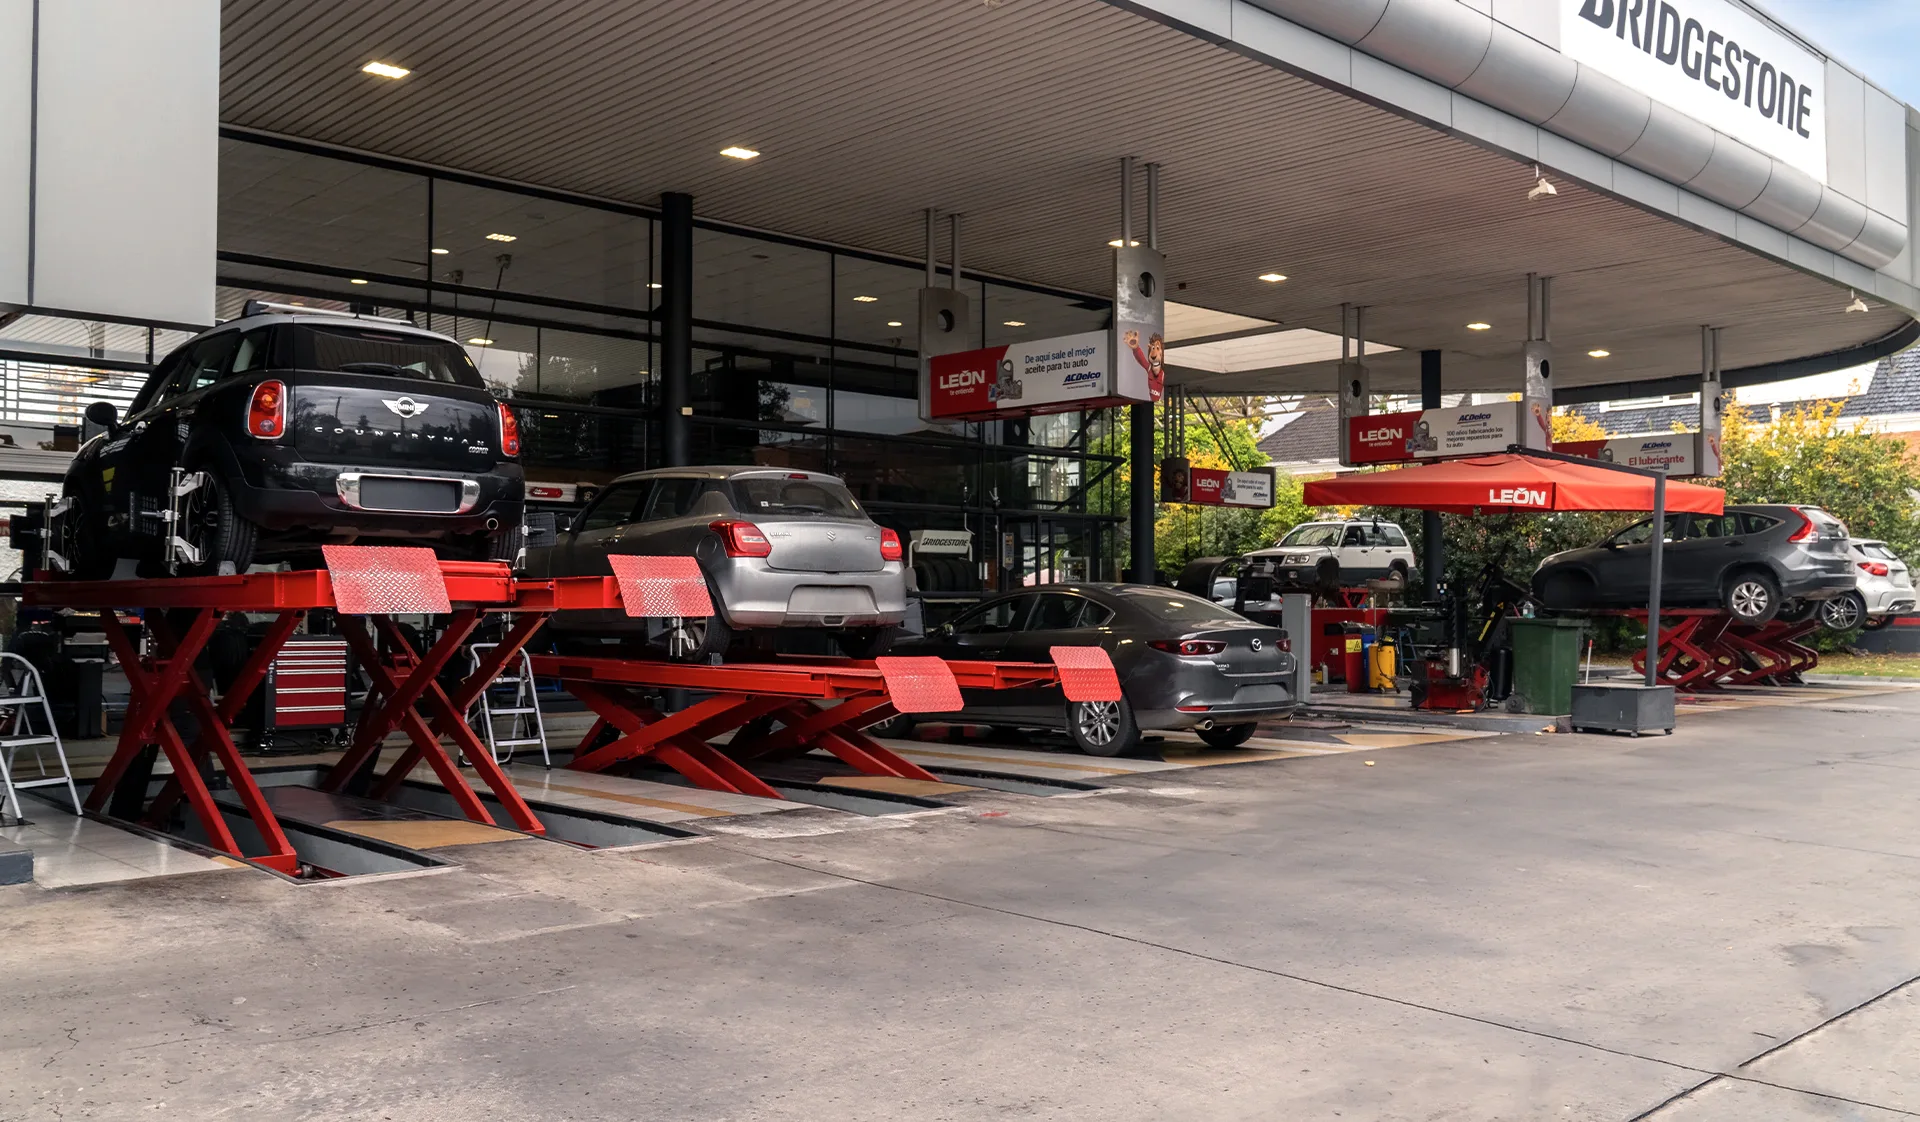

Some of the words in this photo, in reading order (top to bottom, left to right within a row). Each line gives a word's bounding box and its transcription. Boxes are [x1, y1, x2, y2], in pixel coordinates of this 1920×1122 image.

[1025, 355, 1034, 364] De
[1035, 352, 1050, 365] aquí
[1051, 350, 1066, 360] sale
[1067, 348, 1074, 358] el
[1075, 346, 1096, 359] mejor
[1024, 363, 1045, 375] aceite
[1046, 362, 1062, 374] para
[1063, 360, 1072, 370] tu
[1073, 358, 1089, 369] auto
[1064, 371, 1101, 383] ACDelco
[949, 388, 956, 396] te
[956, 386, 975, 396] entiende
[1458, 412, 1492, 422] ACDelco
[314, 426, 485, 446] COUNTRYMAN
[1468, 427, 1495, 435] fabricando
[1446, 436, 1465, 444] mejores
[1466, 434, 1490, 443] repuestos
[1490, 433, 1503, 441] para
[468, 446, 489, 455] COOPER
[1641, 441, 1672, 450] ACDelco
[1628, 457, 1637, 466] El
[1638, 454, 1685, 466] lubricante
[922, 537, 969, 547] BRIDGESTONE
